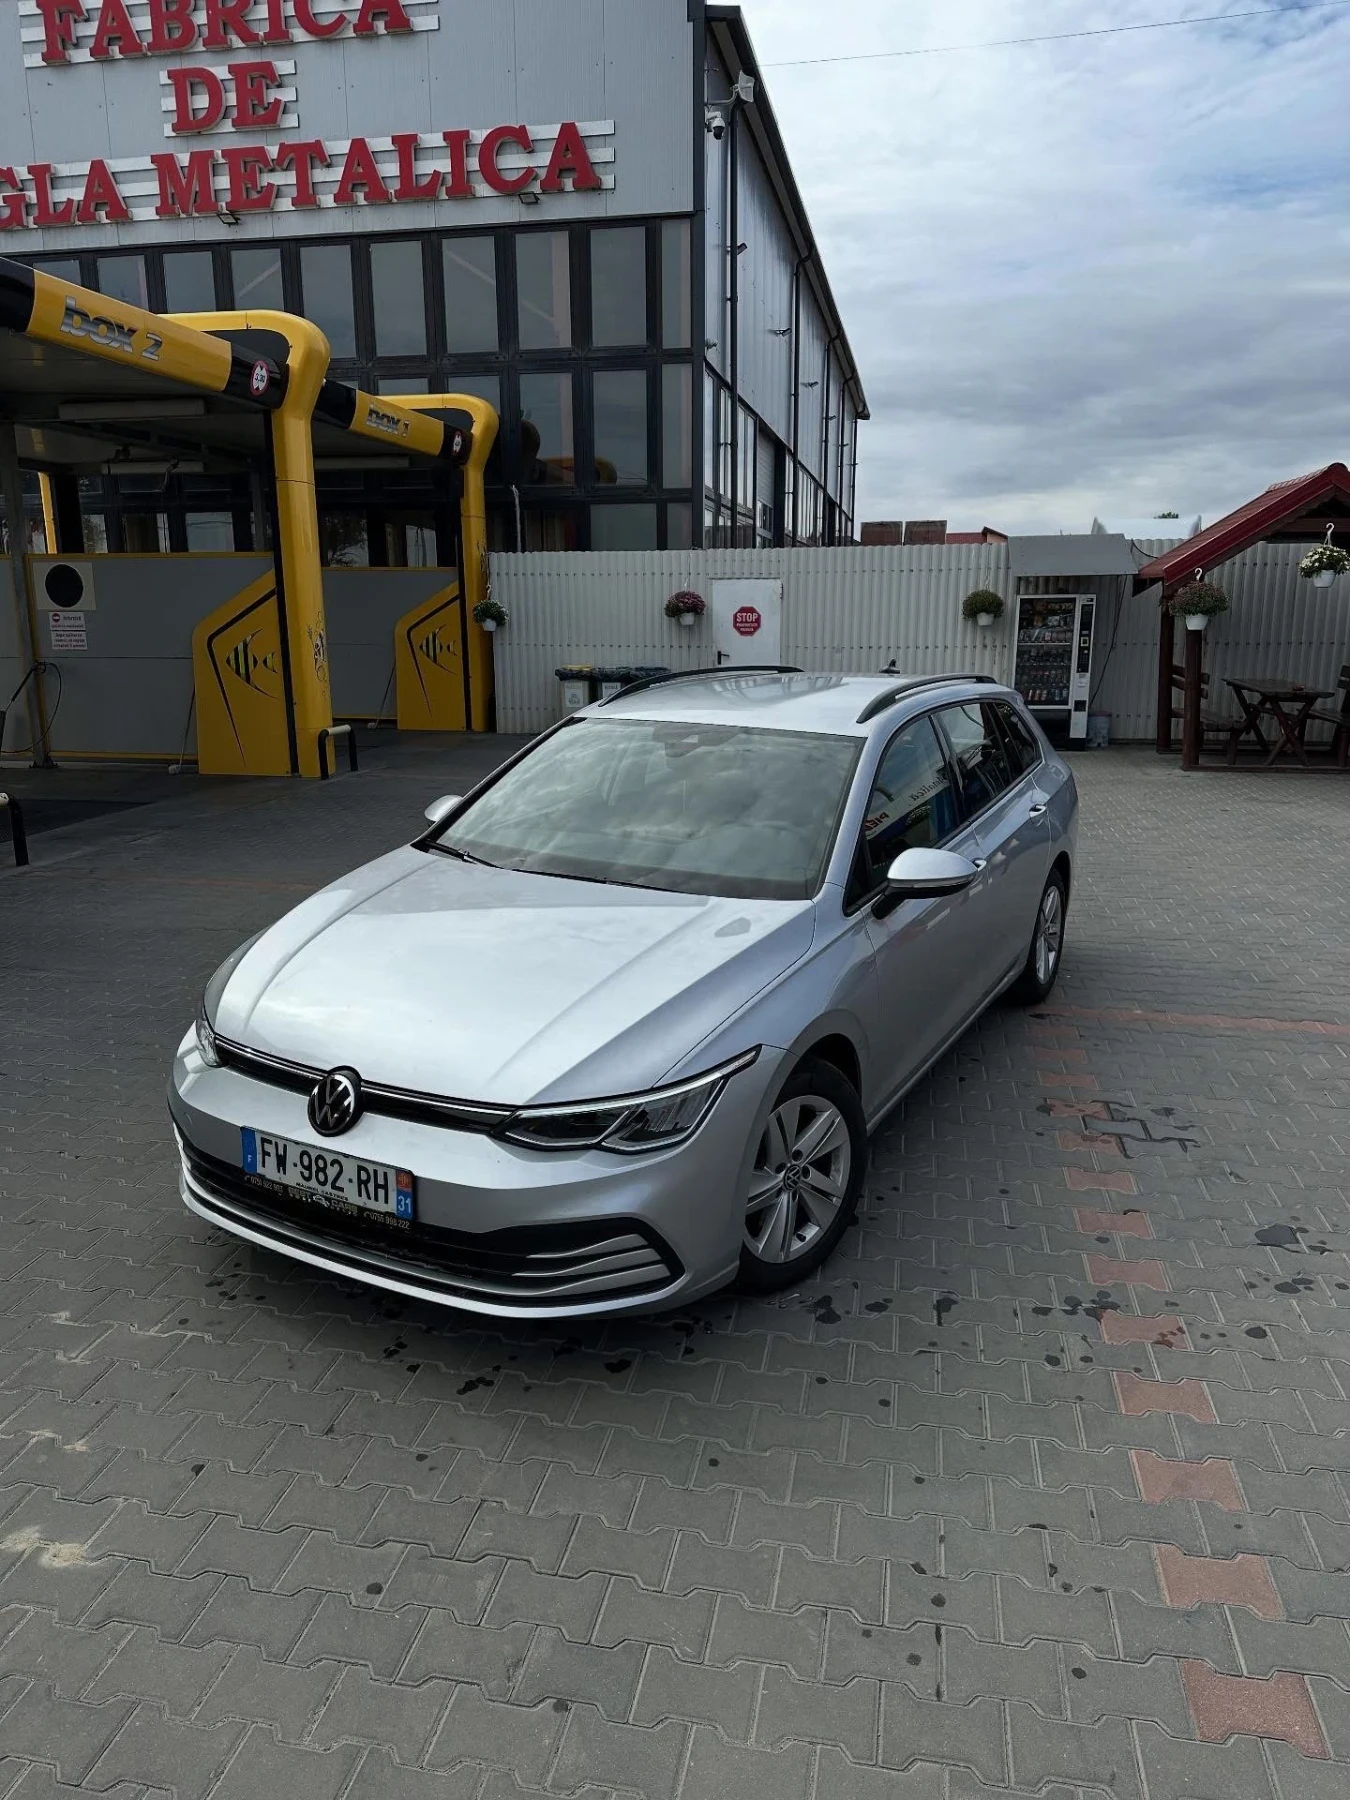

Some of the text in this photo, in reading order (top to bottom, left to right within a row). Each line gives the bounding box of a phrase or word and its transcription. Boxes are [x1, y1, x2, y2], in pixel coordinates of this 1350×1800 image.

[36, 0, 413, 66] FABRICA
[167, 60, 286, 134] DE
[150, 121, 601, 217] METALICA
[61, 295, 163, 361] box 2
[736, 612, 759, 622] STOP
[247, 1155, 252, 1163] F
[397, 1195, 412, 1214] 31
